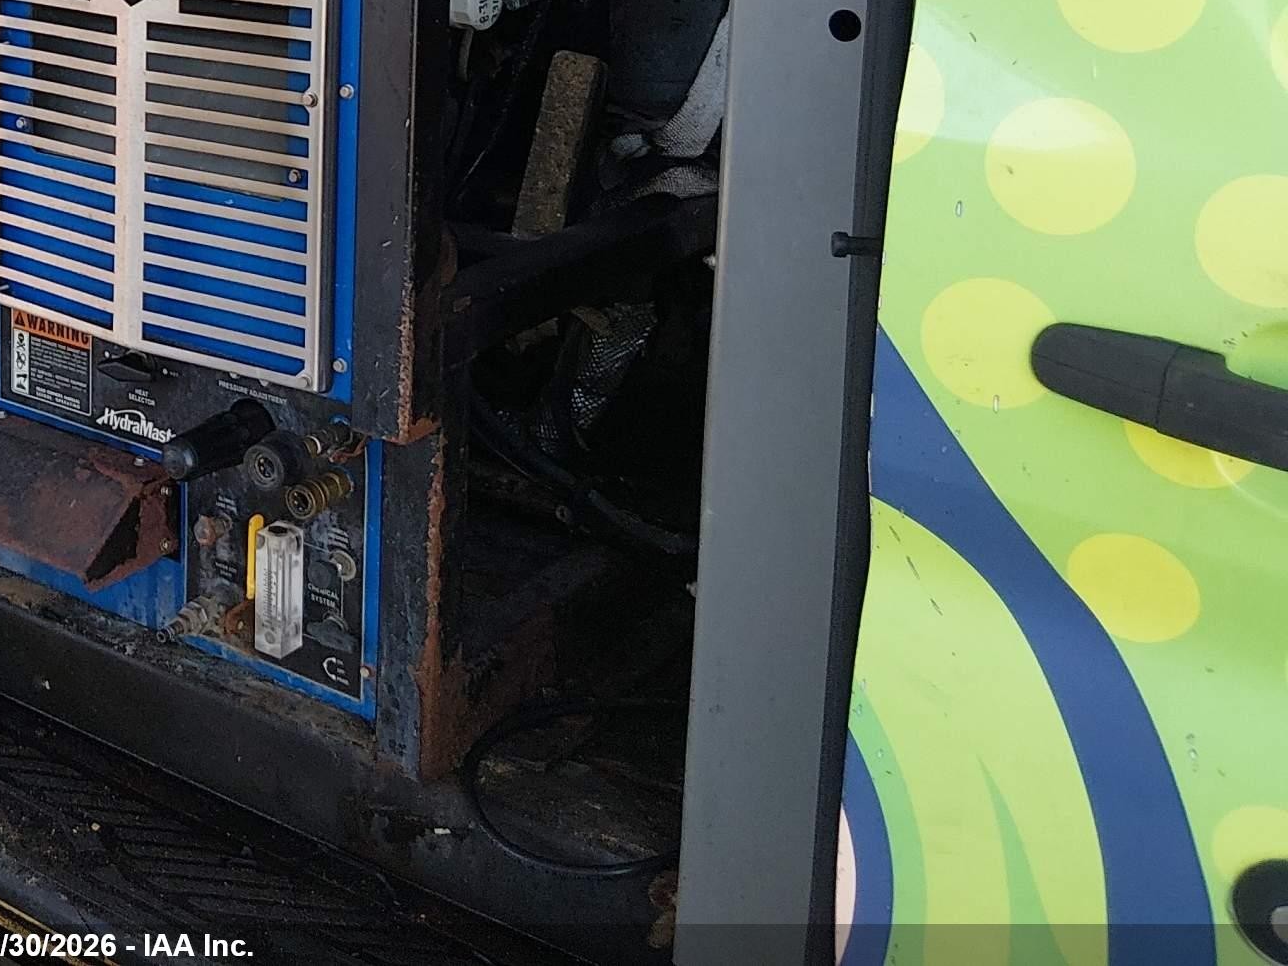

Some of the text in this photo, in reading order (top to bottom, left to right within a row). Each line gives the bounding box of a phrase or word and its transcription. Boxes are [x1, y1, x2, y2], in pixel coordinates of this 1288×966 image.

[27, 314, 89, 344] WARNING
[128, 392, 155, 407] SELECTOR
[96, 407, 177, 444] HydraMast
[308, 583, 340, 601] CHEMICAL
[311, 592, 336, 609] SYSTEM
